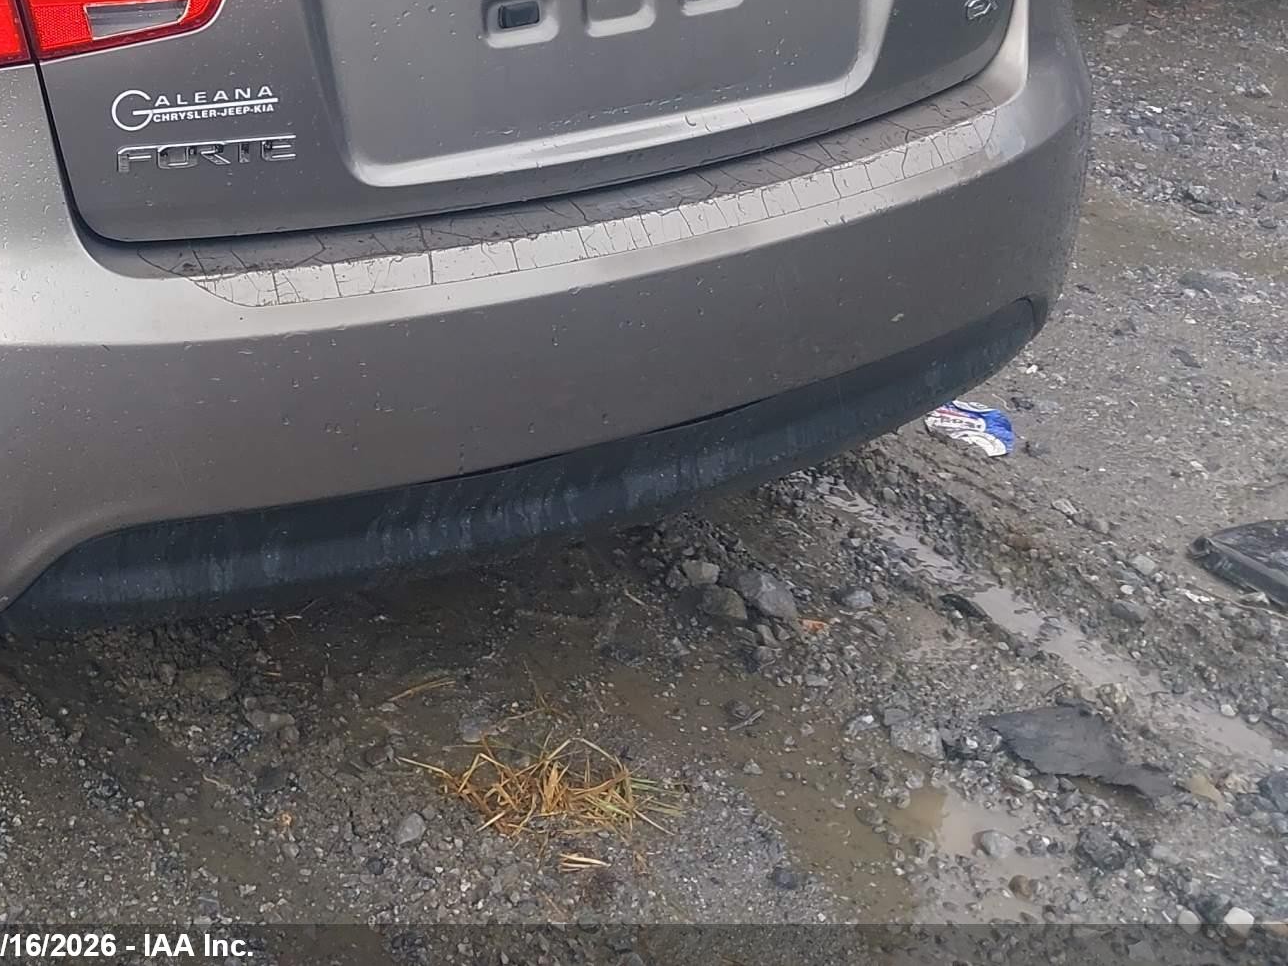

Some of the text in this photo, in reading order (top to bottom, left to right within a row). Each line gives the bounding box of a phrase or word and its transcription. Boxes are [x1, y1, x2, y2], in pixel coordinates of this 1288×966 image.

[112, 86, 278, 131] GALEANA
[153, 103, 274, 123] CHRYSLER-JEEP-KIA
[117, 135, 296, 173] FORTE
